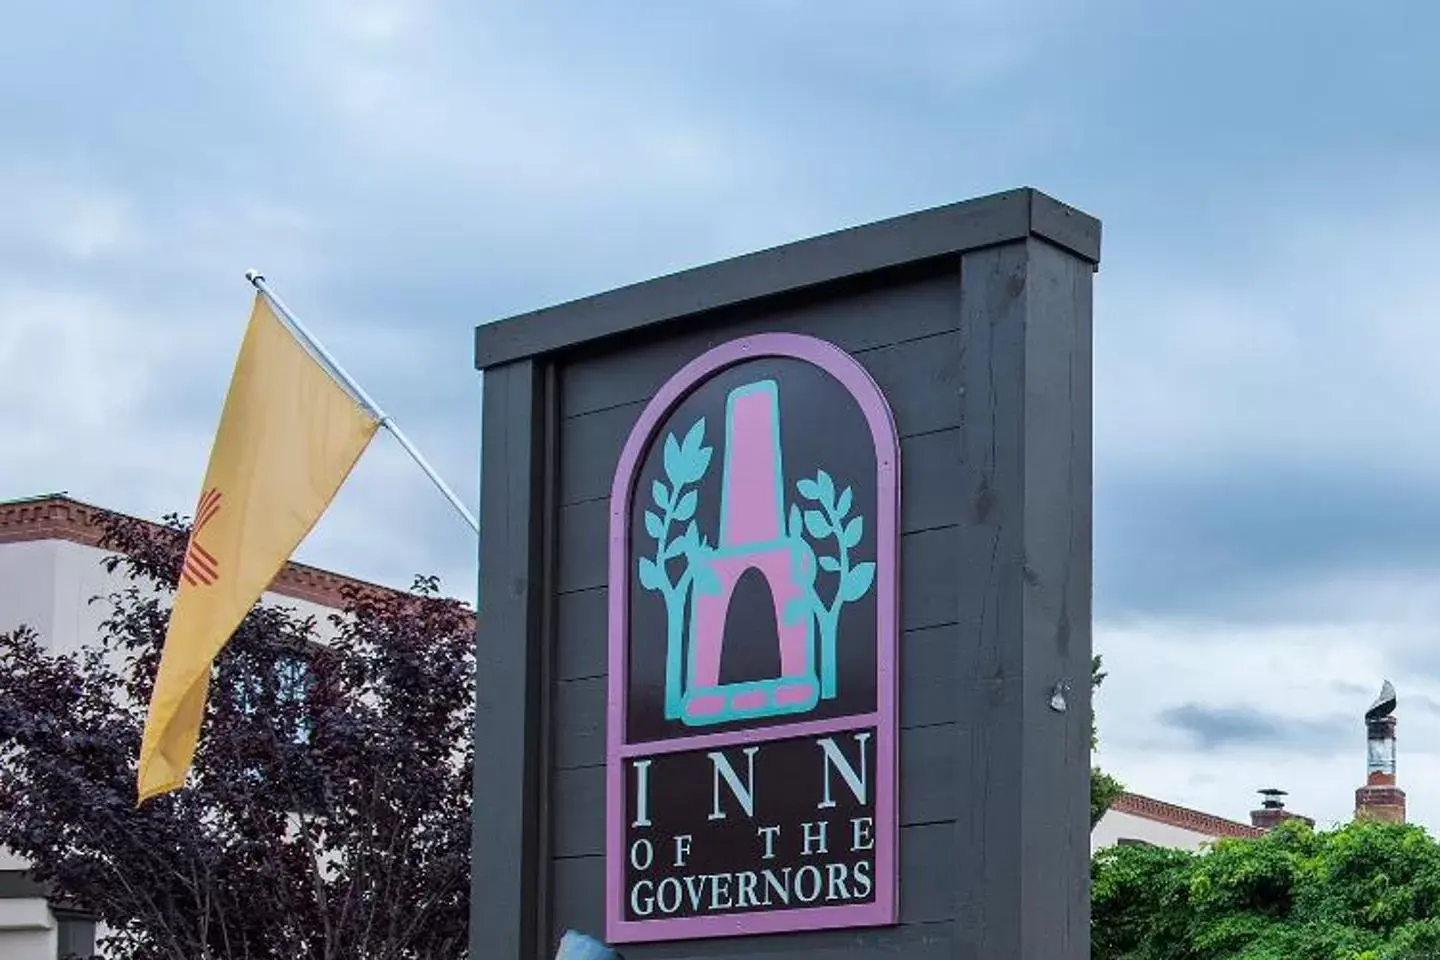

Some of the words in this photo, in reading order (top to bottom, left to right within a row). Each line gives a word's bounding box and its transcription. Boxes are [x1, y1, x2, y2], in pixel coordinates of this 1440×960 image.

[632, 733, 871, 828] INN
[631, 834, 692, 871] OF
[758, 817, 874, 859] THE
[631, 861, 872, 915] GOVERNORS
